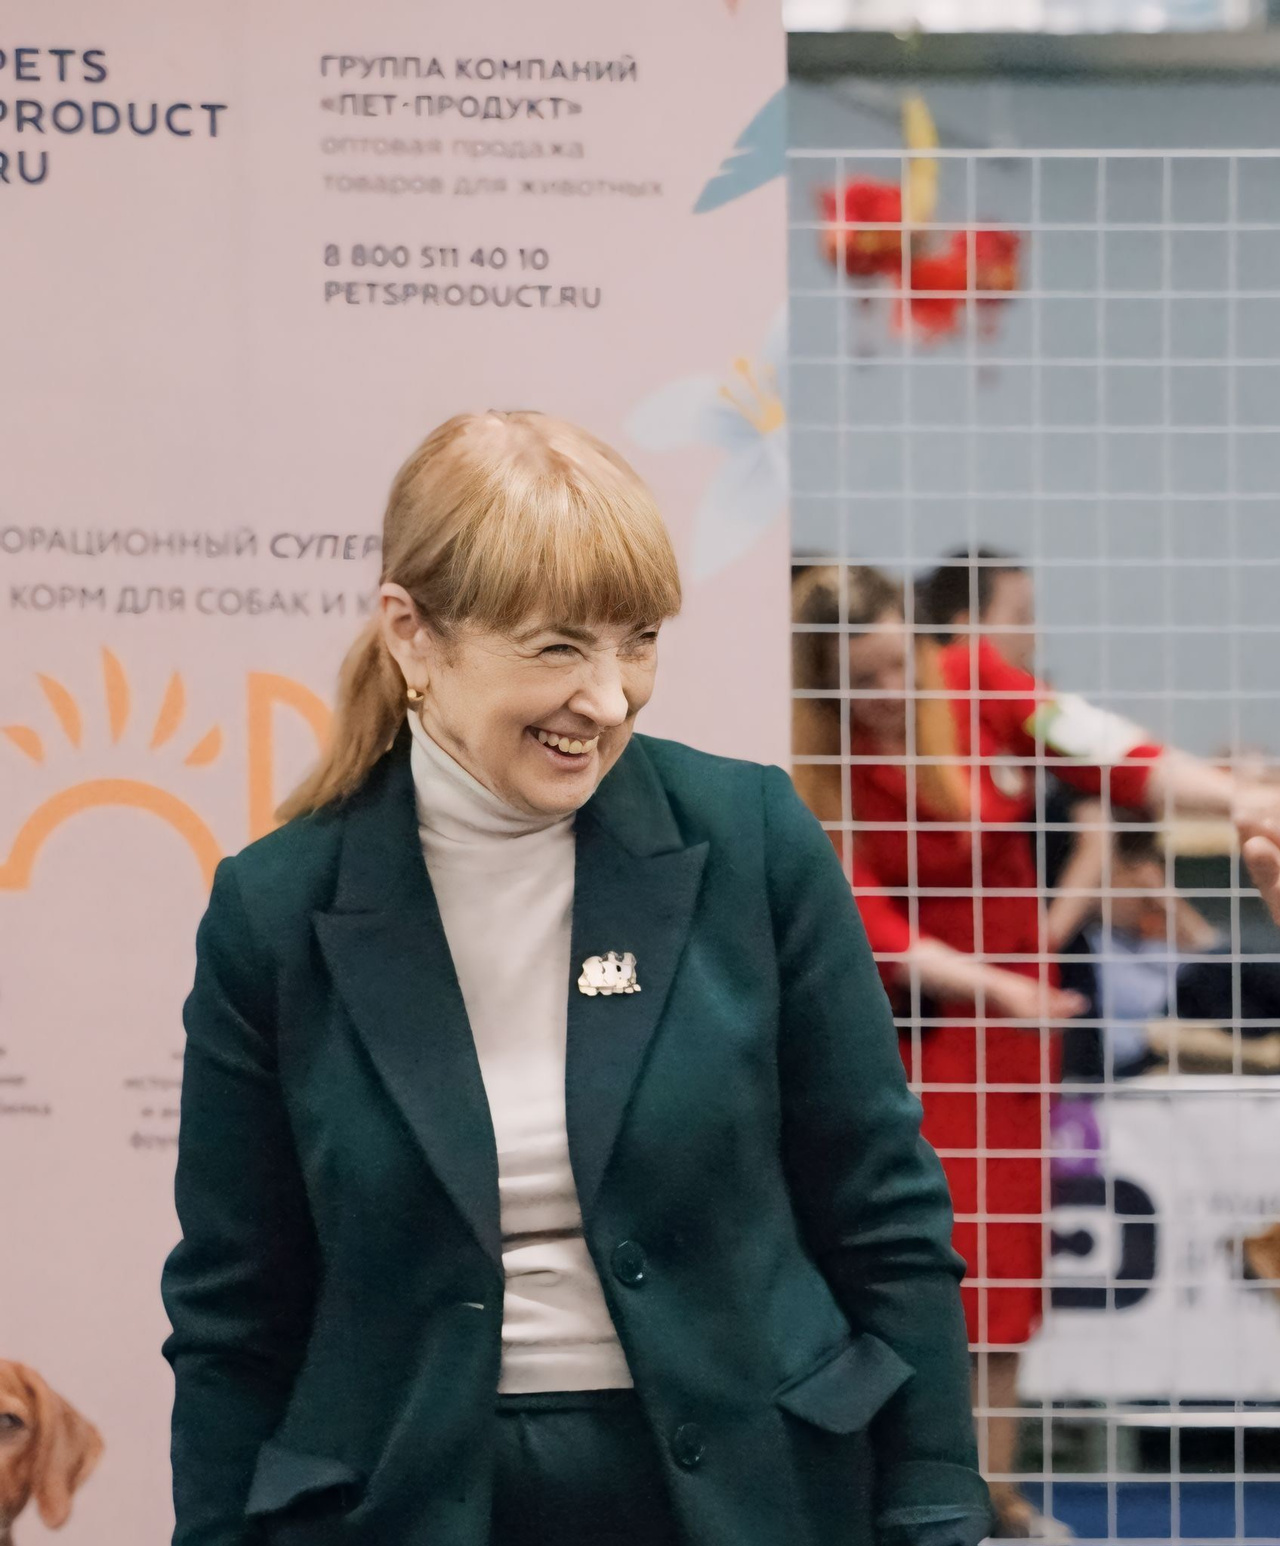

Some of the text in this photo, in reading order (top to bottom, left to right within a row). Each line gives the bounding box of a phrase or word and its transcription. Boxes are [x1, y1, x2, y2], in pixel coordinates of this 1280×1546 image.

[0, 47, 108, 84] ETS
[320, 54, 638, 82] ГРУППА КОМПАНИЙ
[323, 243, 550, 271] 8 800 511 40 10
[323, 280, 601, 309] PETSPRODUCT.RU
[9, 582, 107, 613] КОРМ
[116, 585, 187, 616] ДЛЯ
[195, 586, 311, 617] СОБАК
[320, 591, 347, 616] И
